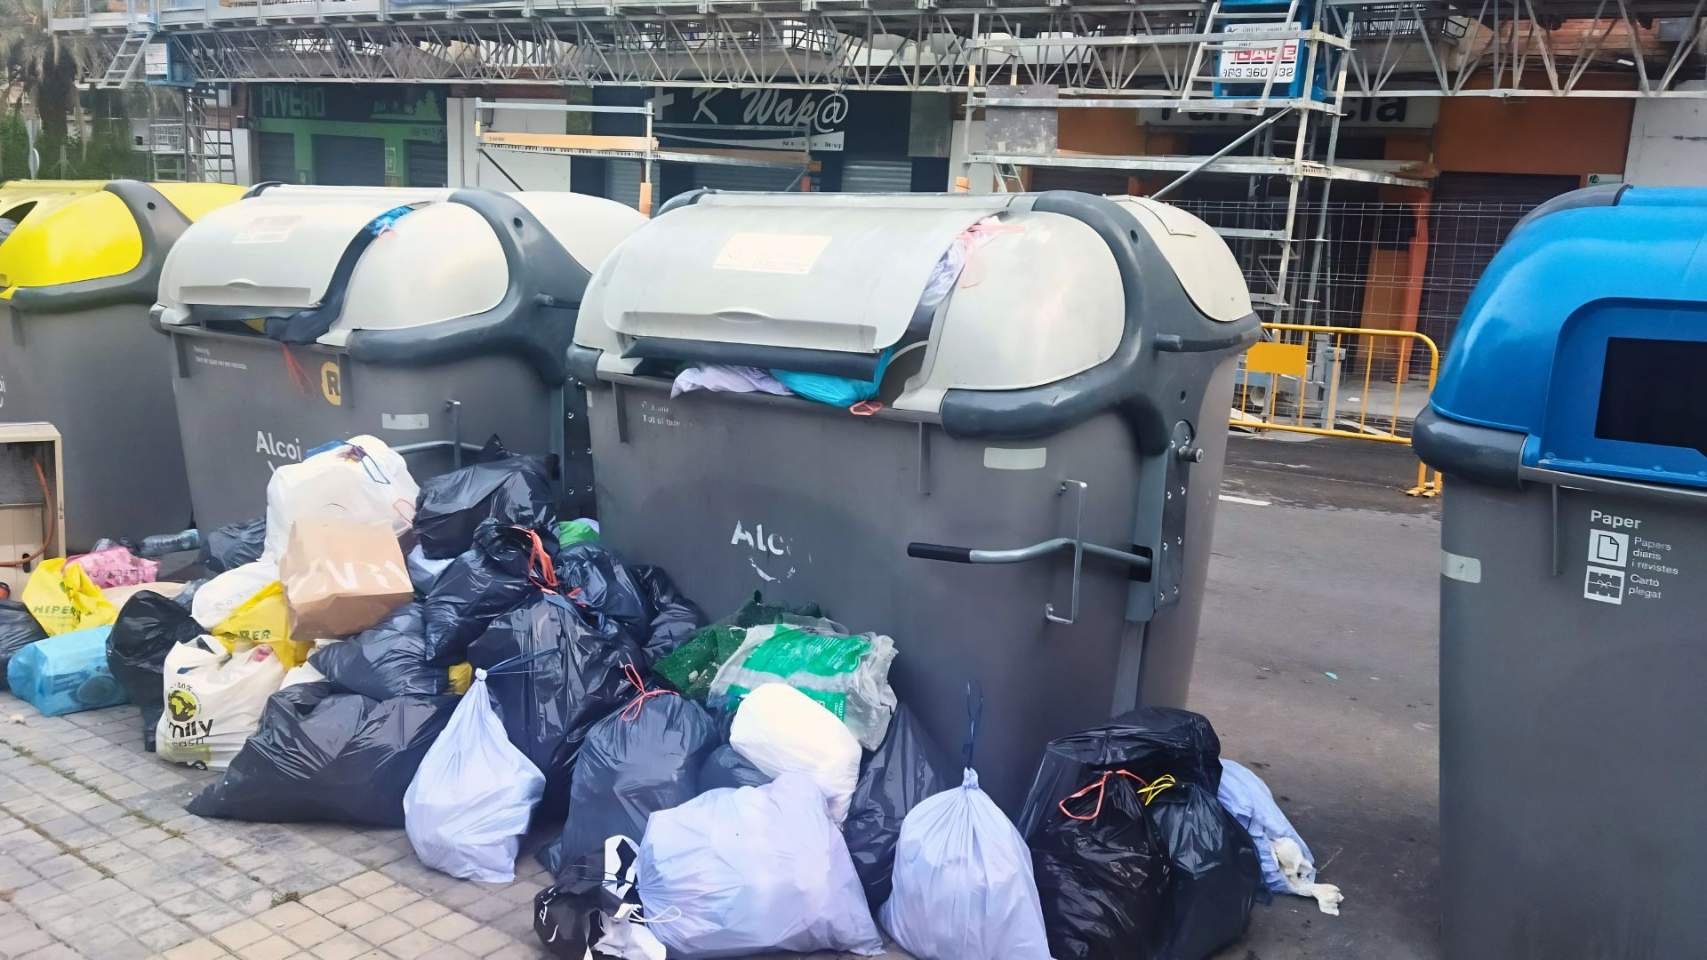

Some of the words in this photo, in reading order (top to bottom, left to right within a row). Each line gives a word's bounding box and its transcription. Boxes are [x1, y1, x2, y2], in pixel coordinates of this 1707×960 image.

[1246, 67, 1268, 78] 360
[692, 87, 723, 124] K
[256, 430, 302, 462] Alcoi
[1590, 509, 1642, 529] Paper
[730, 520, 793, 556] Alc
[1634, 536, 1672, 551] Papers
[1637, 560, 1679, 575] revistes
